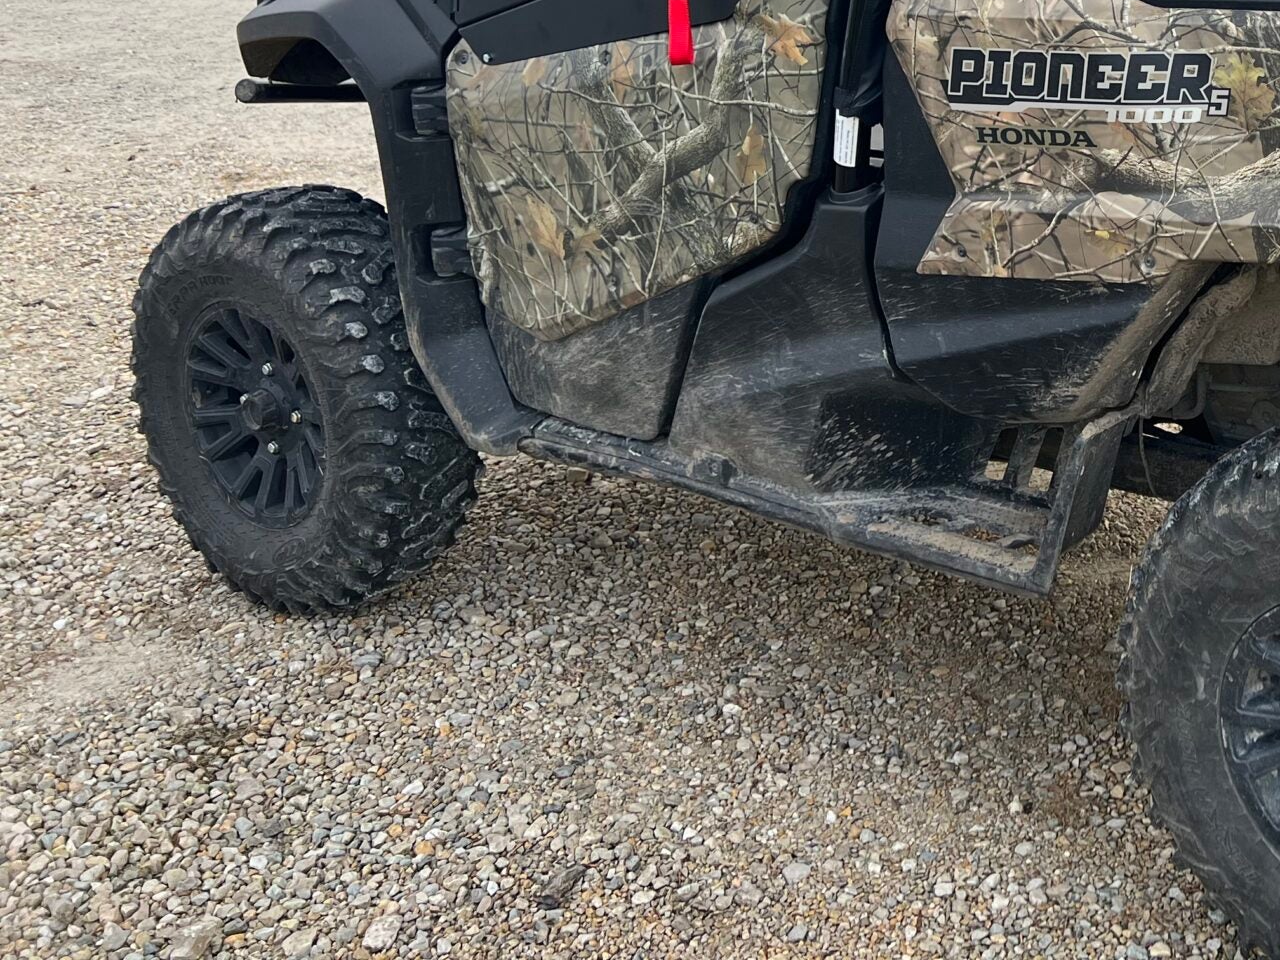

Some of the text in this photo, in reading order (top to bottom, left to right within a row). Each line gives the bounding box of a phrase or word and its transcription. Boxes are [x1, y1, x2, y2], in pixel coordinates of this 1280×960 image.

[948, 46, 1215, 105] PIONEER
[1106, 106, 1202, 124] 1000
[975, 126, 1098, 148] HONDA
